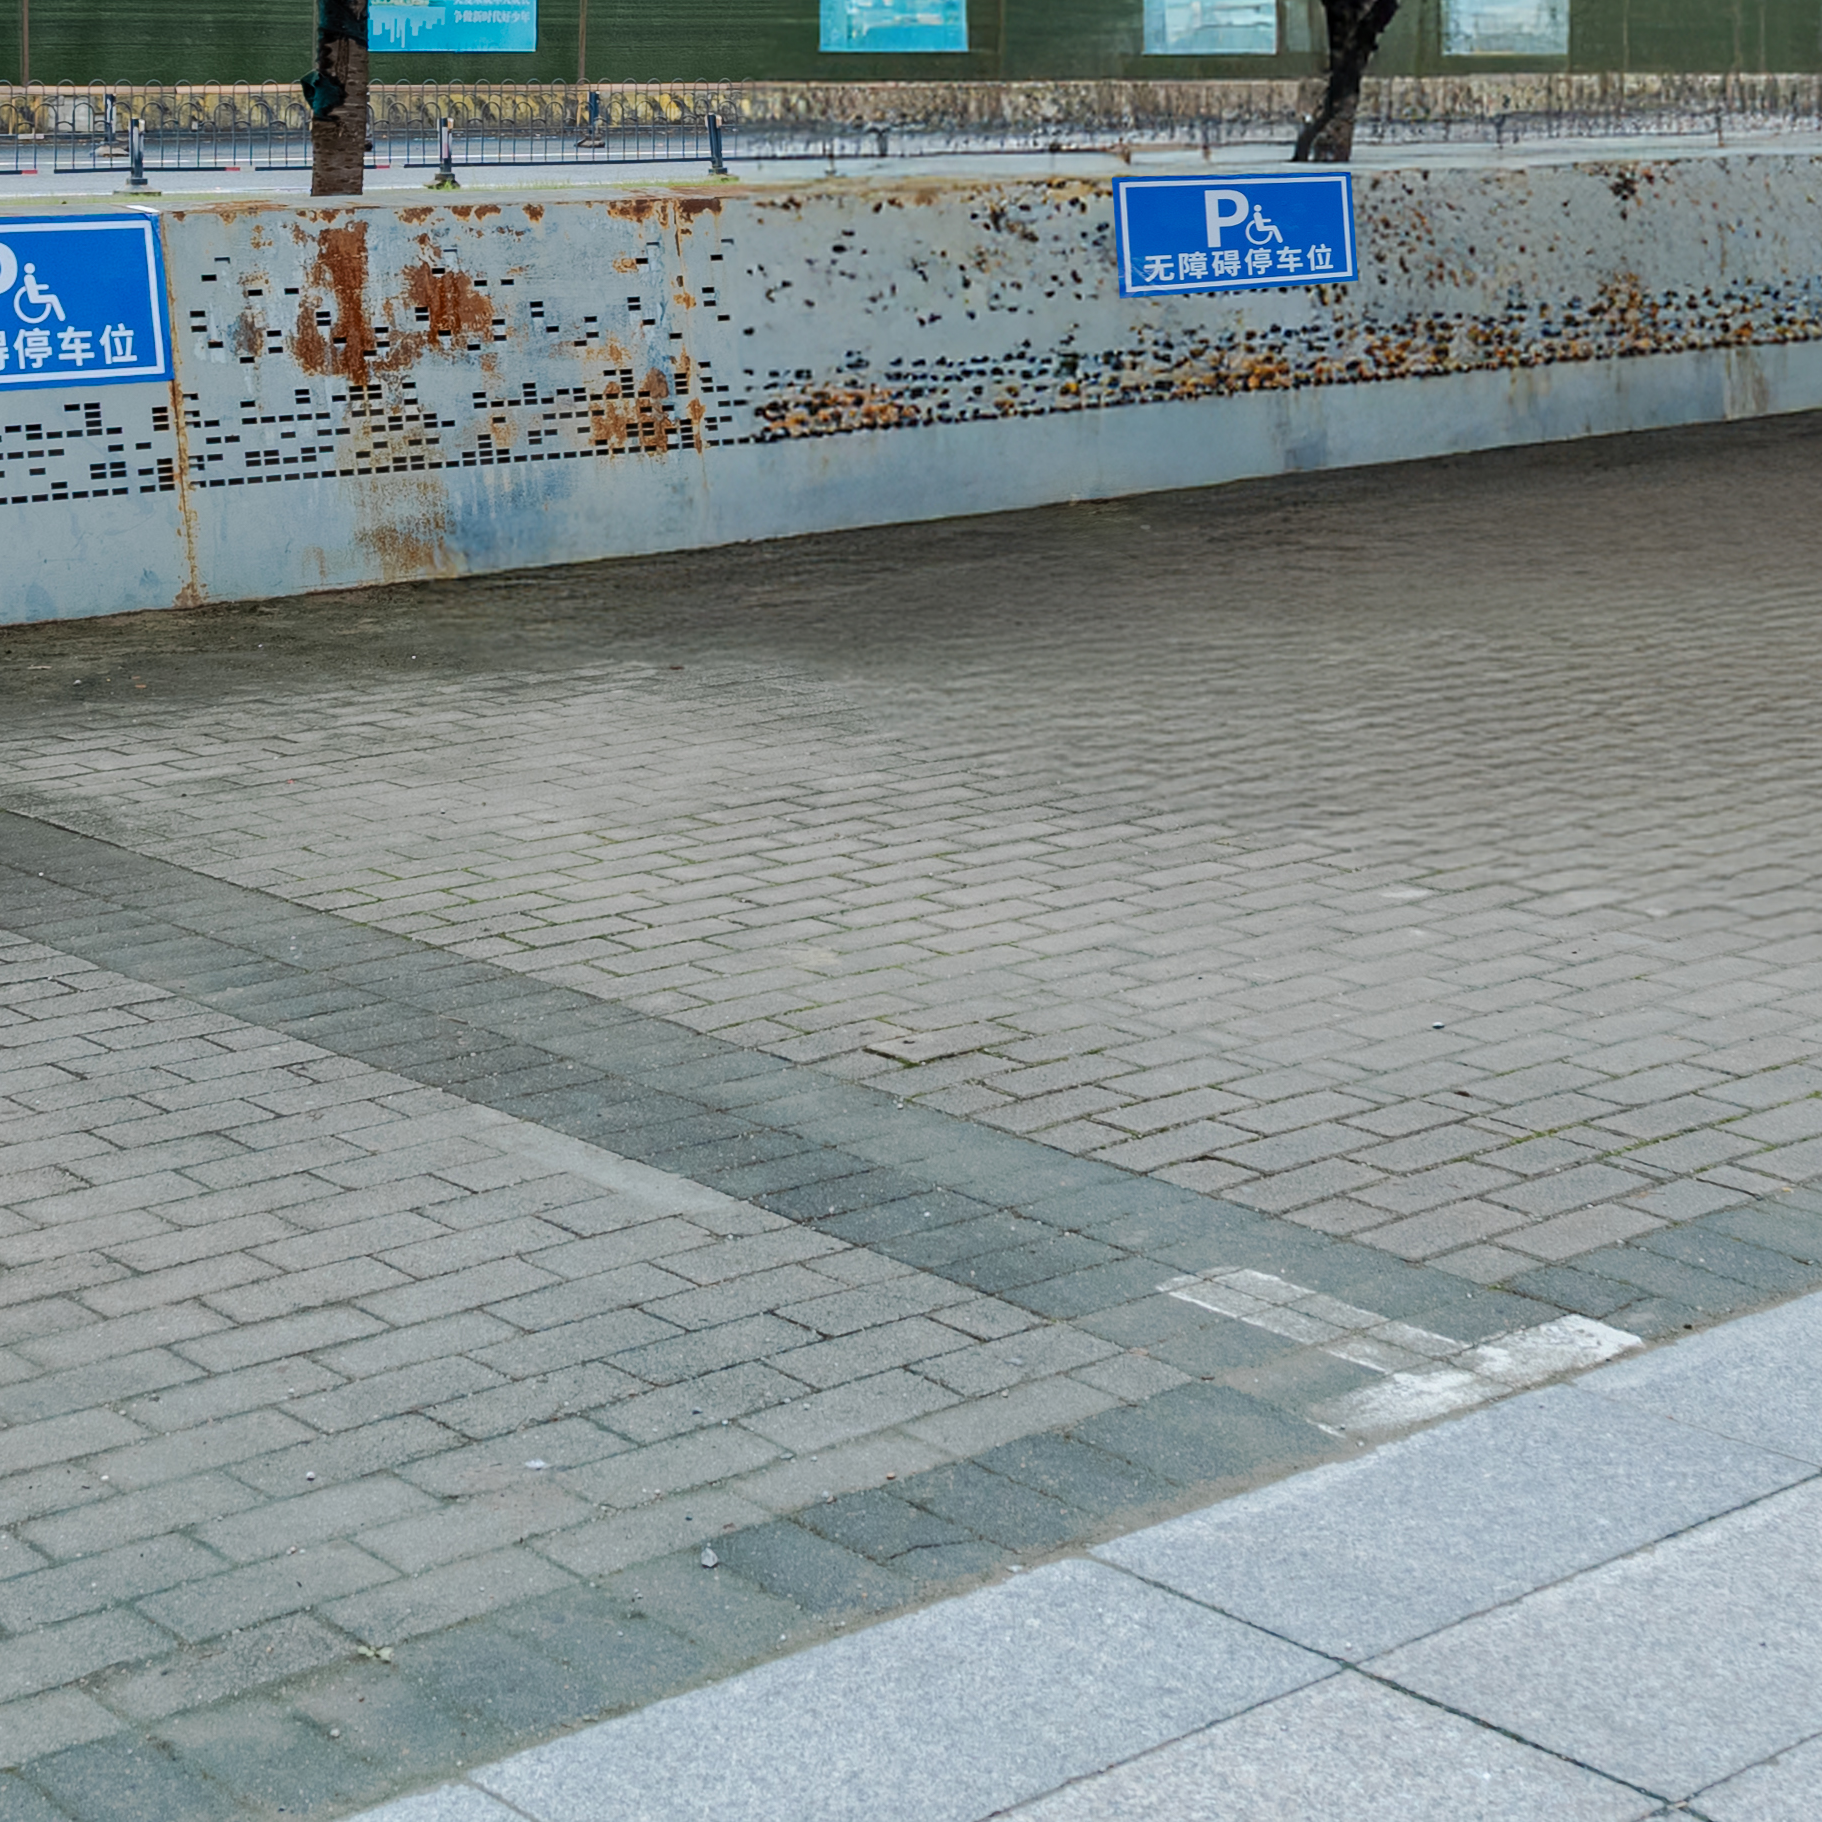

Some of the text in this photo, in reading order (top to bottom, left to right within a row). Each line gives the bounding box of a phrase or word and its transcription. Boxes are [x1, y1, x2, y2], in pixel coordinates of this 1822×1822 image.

[454, 10, 531, 24] 争做新时代好少年
[1204, 189, 1249, 248] P
[1144, 243, 1334, 282] 无障碍停车位
